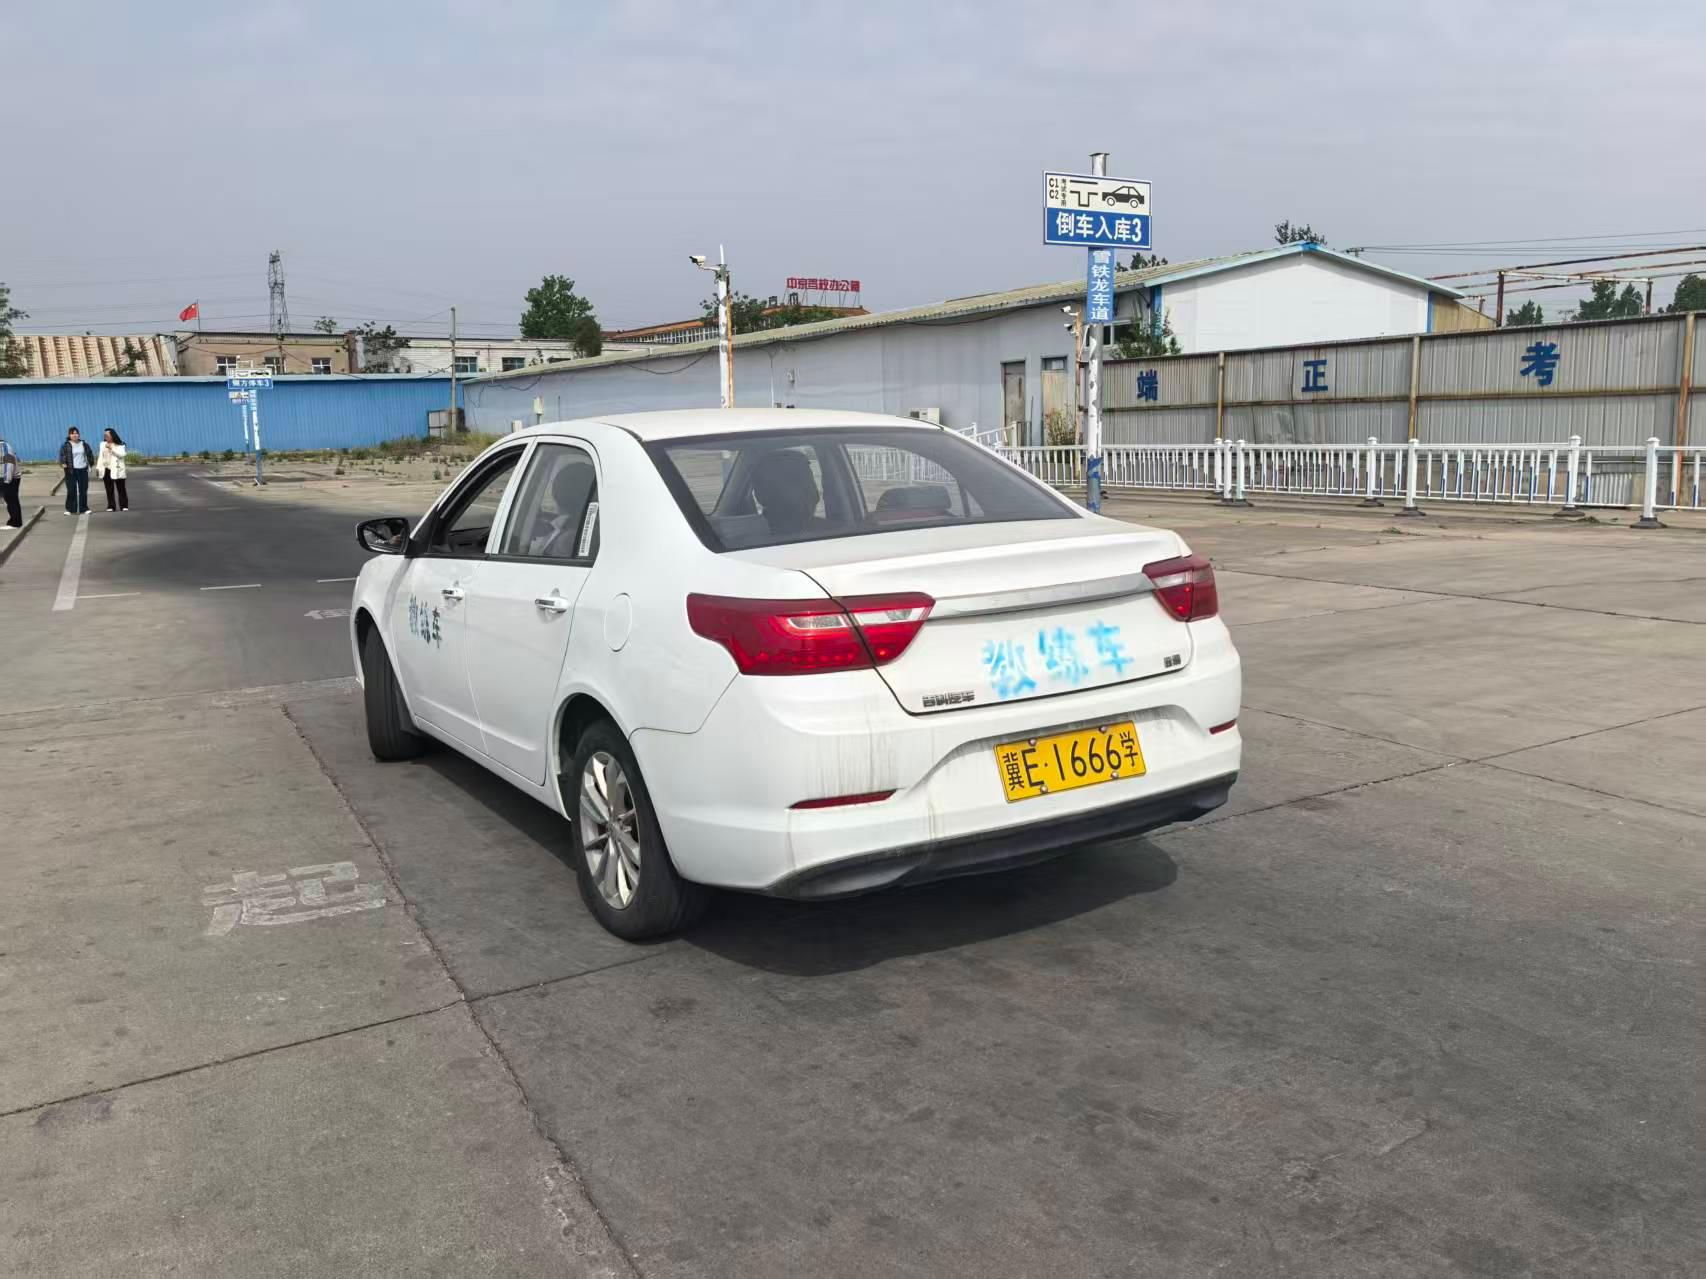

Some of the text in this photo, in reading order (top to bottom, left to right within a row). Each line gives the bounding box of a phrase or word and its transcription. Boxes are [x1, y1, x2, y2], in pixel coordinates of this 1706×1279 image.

[1048, 178, 1059, 187] C1
[1049, 190, 1059, 199] C2
[1056, 211, 1142, 242] 倒车入库3
[1091, 250, 1111, 320] 雪铁龙车道
[1137, 341, 1560, 401] 端 正 考
